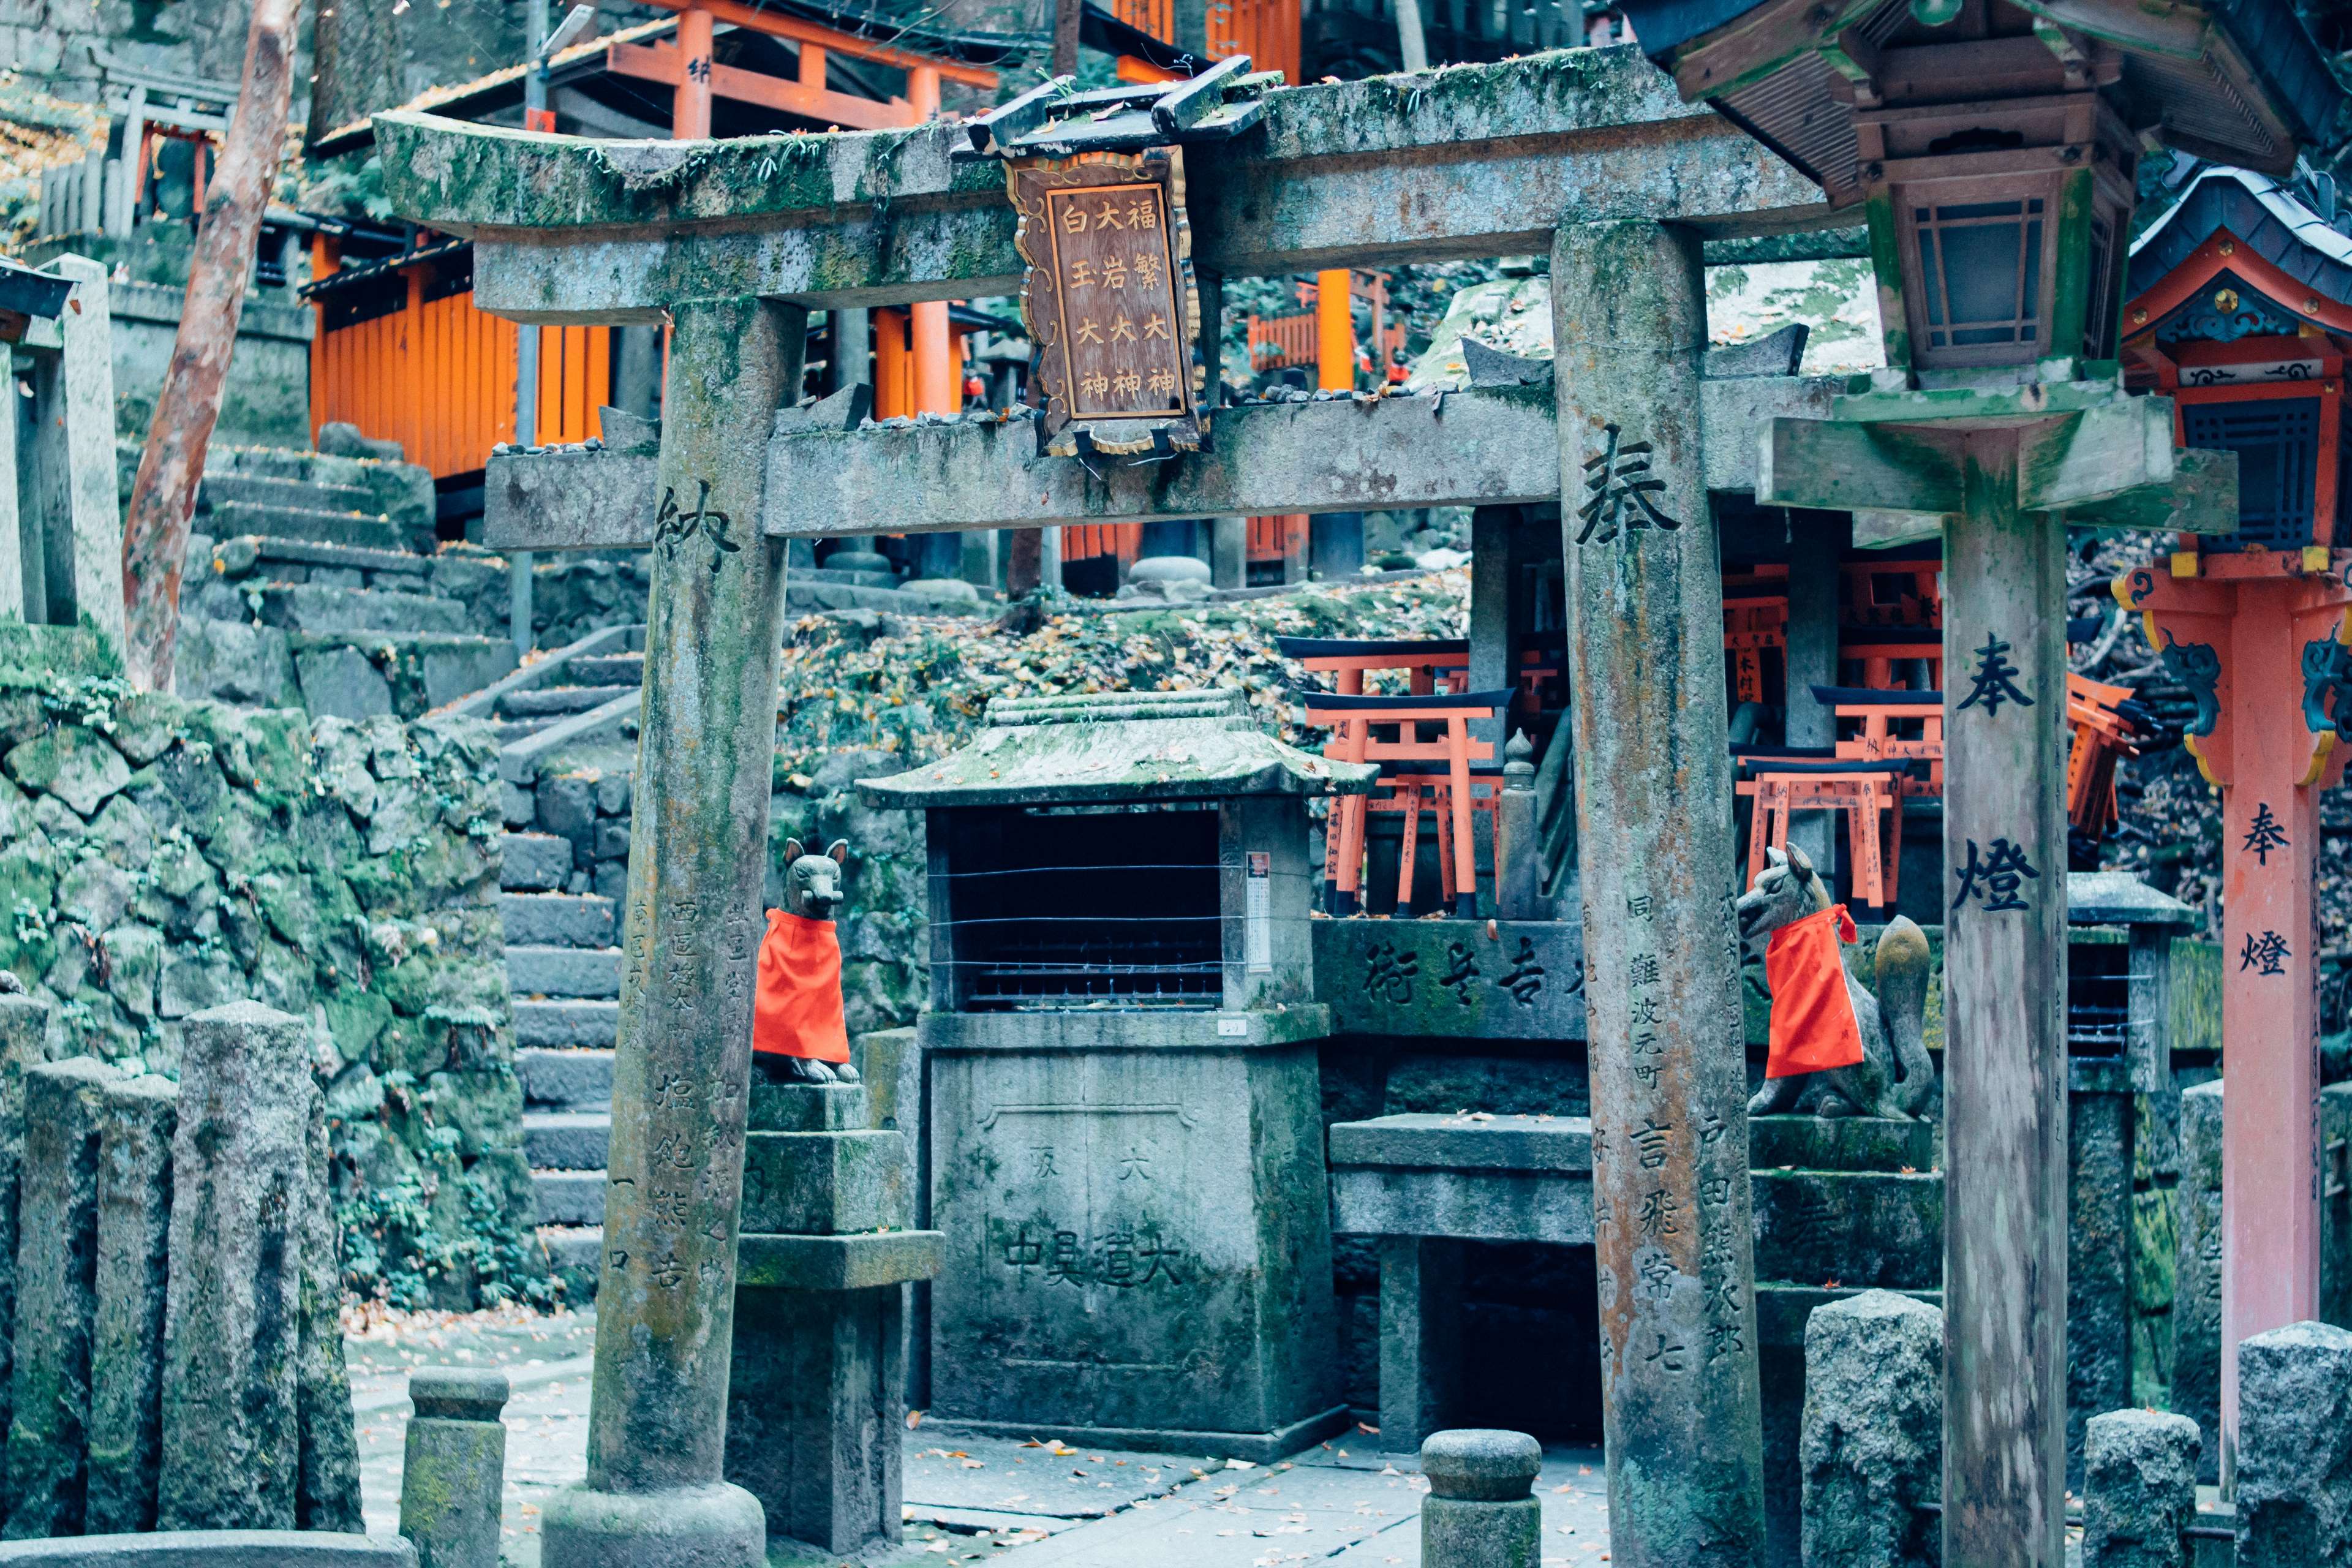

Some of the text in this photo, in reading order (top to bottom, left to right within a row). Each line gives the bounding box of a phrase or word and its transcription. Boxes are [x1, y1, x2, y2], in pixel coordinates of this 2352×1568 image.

[1063, 204, 1109, 402] 白玉大神
[1095, 200, 1141, 402] 大岩大神
[1128, 200, 1176, 400] 福繁大神
[655, 480, 741, 574] 納
[1576, 423, 1682, 547] 奉
[1951, 631, 2040, 912] 奉燈
[2240, 802, 2292, 976] 奉燈
